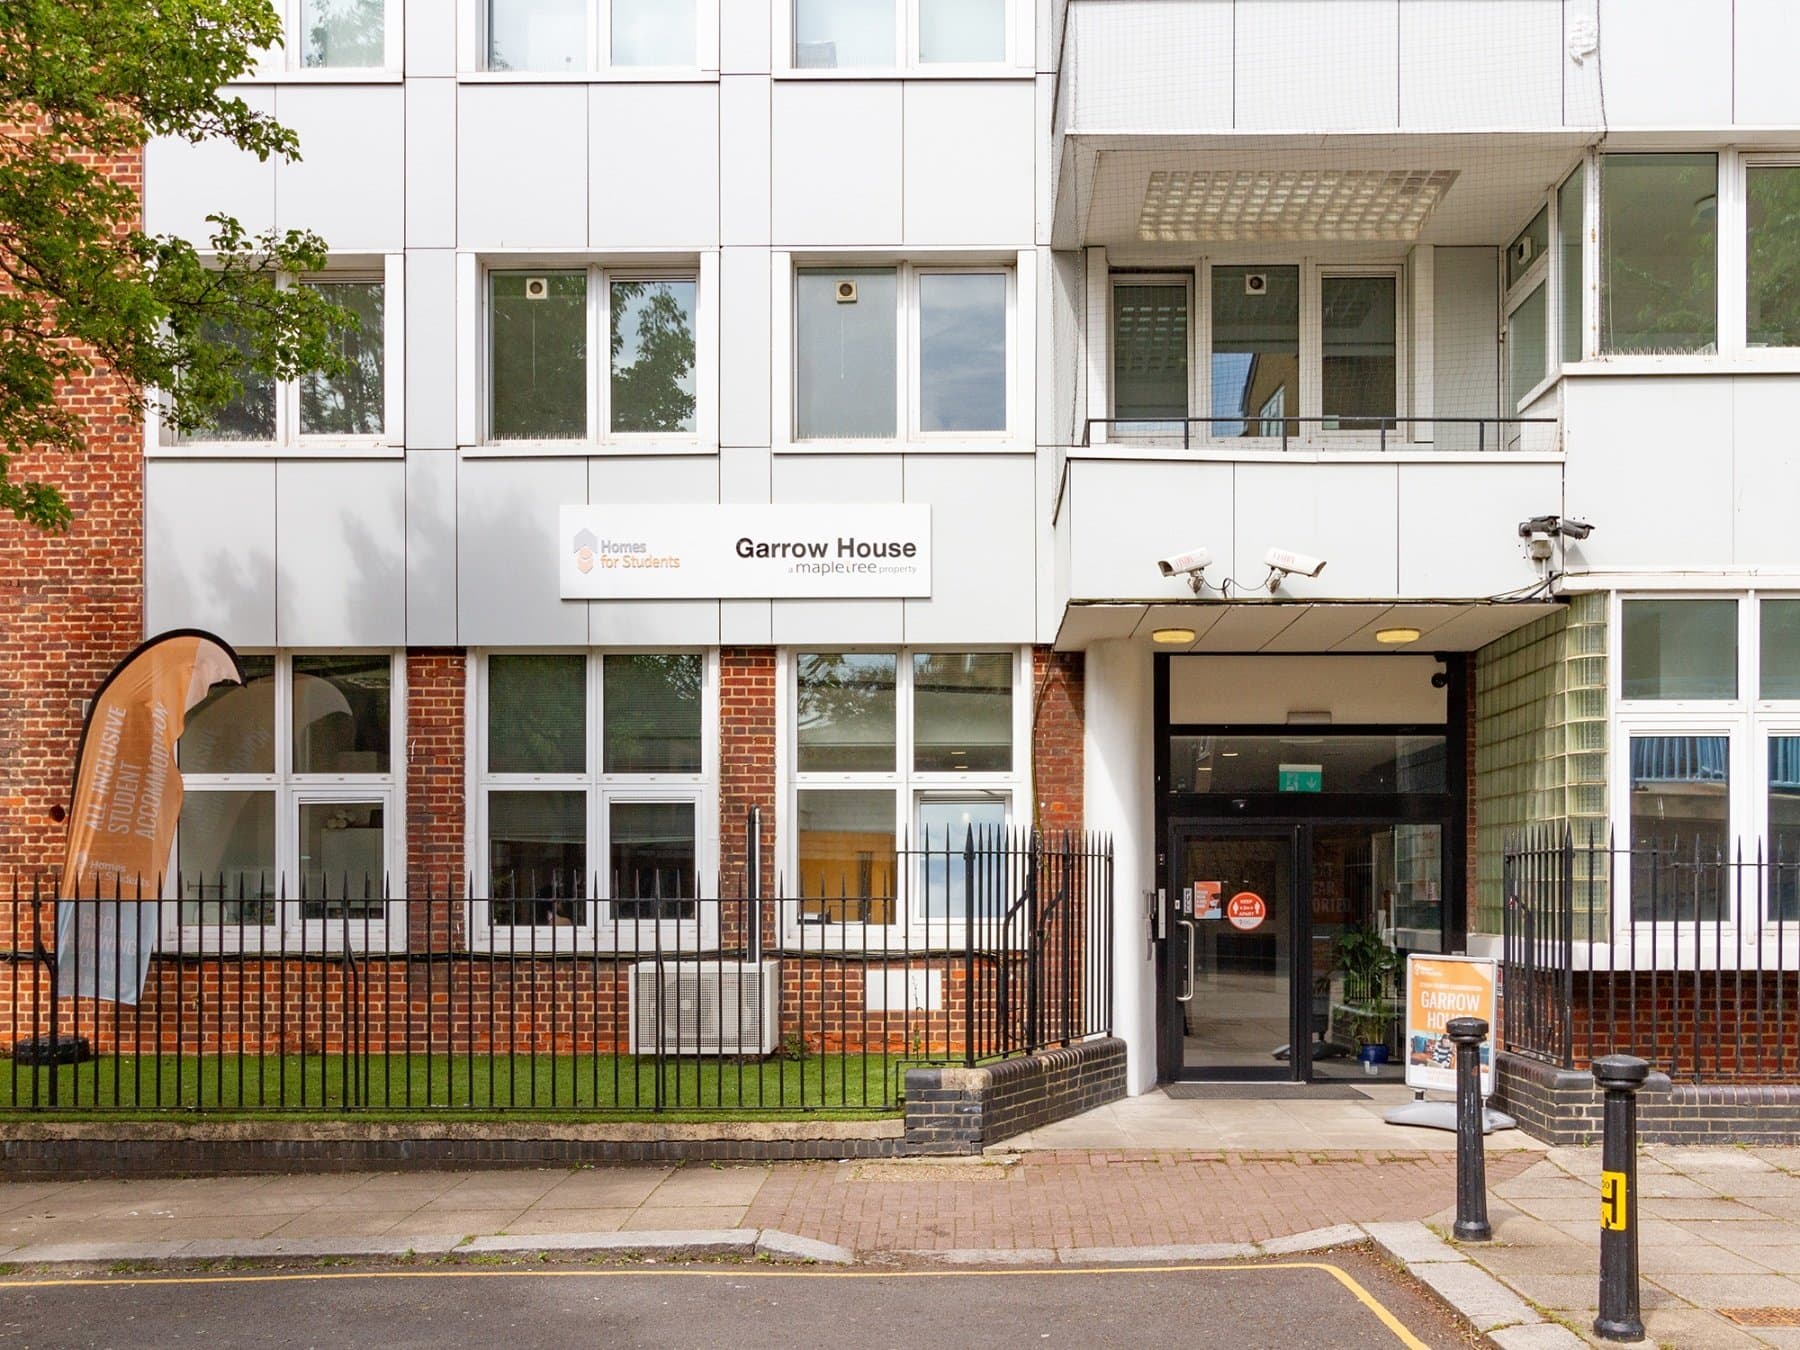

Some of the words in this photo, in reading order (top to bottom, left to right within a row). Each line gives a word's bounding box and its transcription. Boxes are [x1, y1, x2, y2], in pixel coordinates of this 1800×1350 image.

[601, 540, 647, 554] Homes
[736, 537, 828, 558] Garrow
[837, 537, 917, 558] House
[600, 554, 620, 569] for
[622, 554, 680, 569] Students
[795, 561, 877, 576] mapletree
[879, 565, 918, 576] property
[108, 759, 142, 834] STUDENT
[1421, 991, 1480, 1012] GARROW
